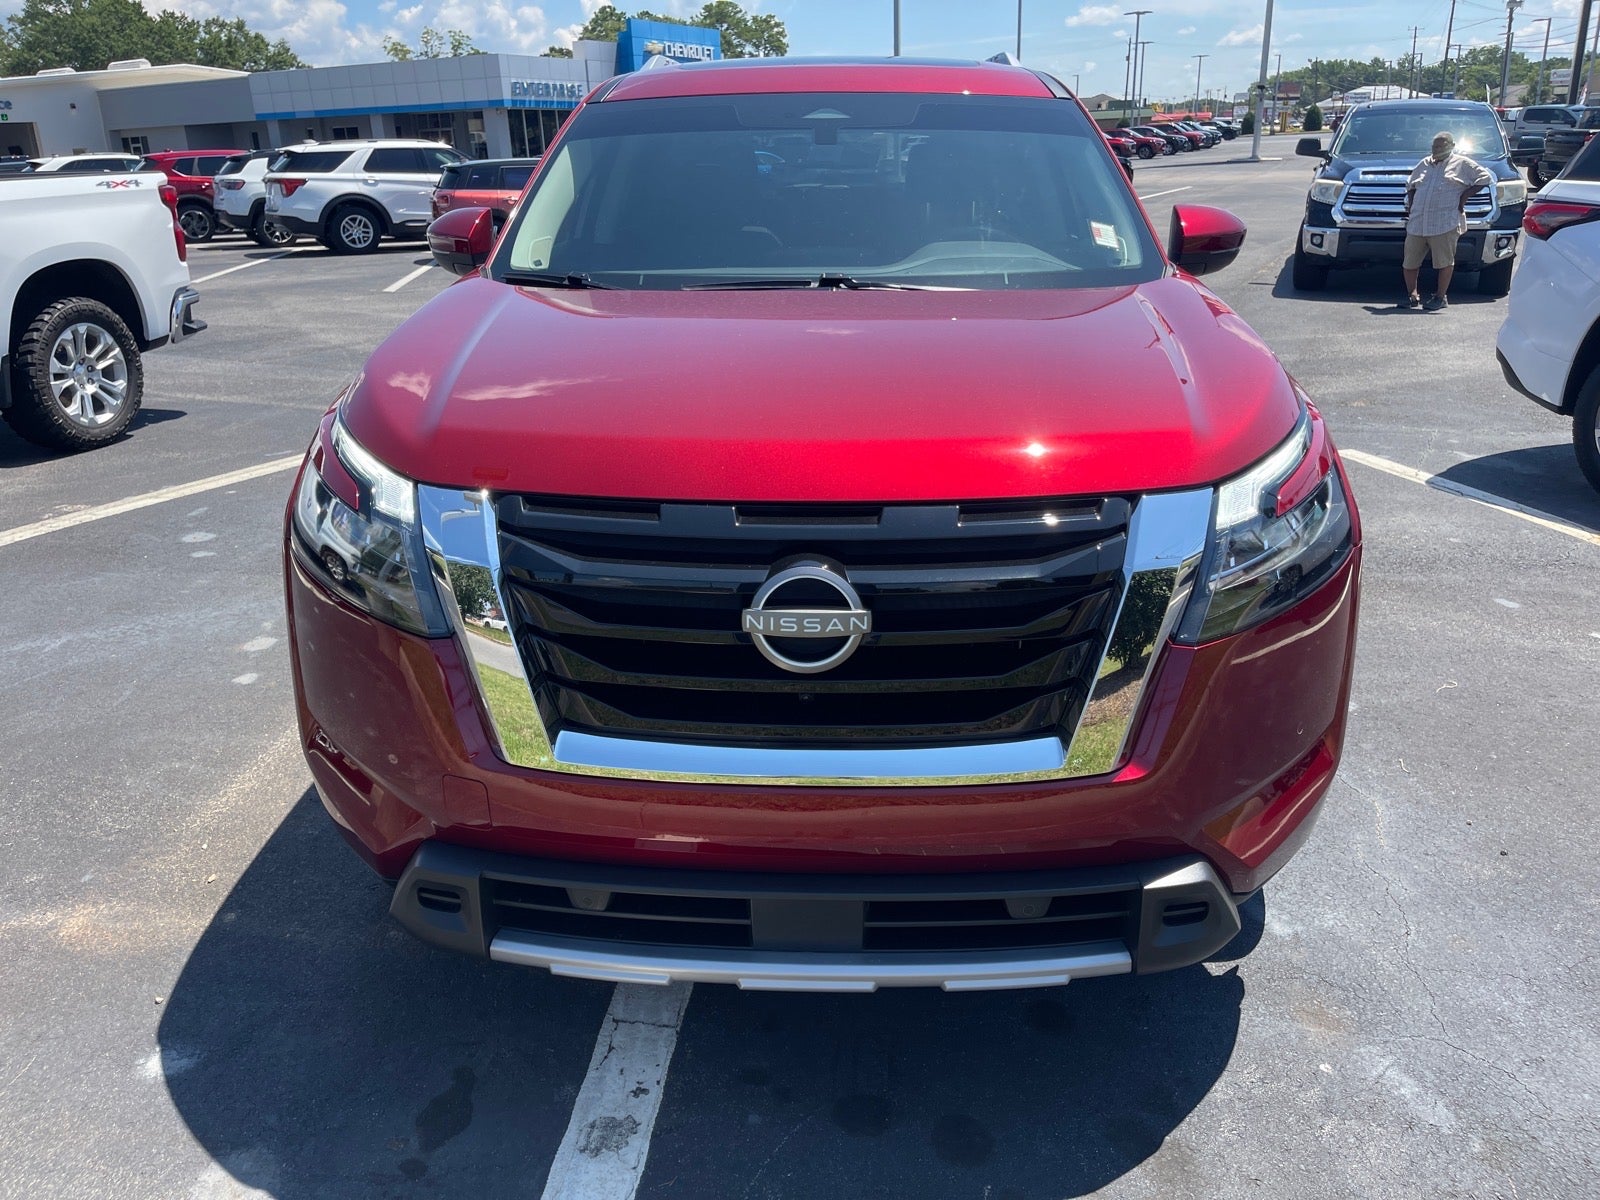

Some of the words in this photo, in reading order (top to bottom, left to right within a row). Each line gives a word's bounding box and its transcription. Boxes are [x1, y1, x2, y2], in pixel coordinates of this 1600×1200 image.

[664, 42, 714, 61] CHEVROLET
[511, 80, 584, 98] ENTERPRISE
[746, 614, 868, 633] NISSAN
